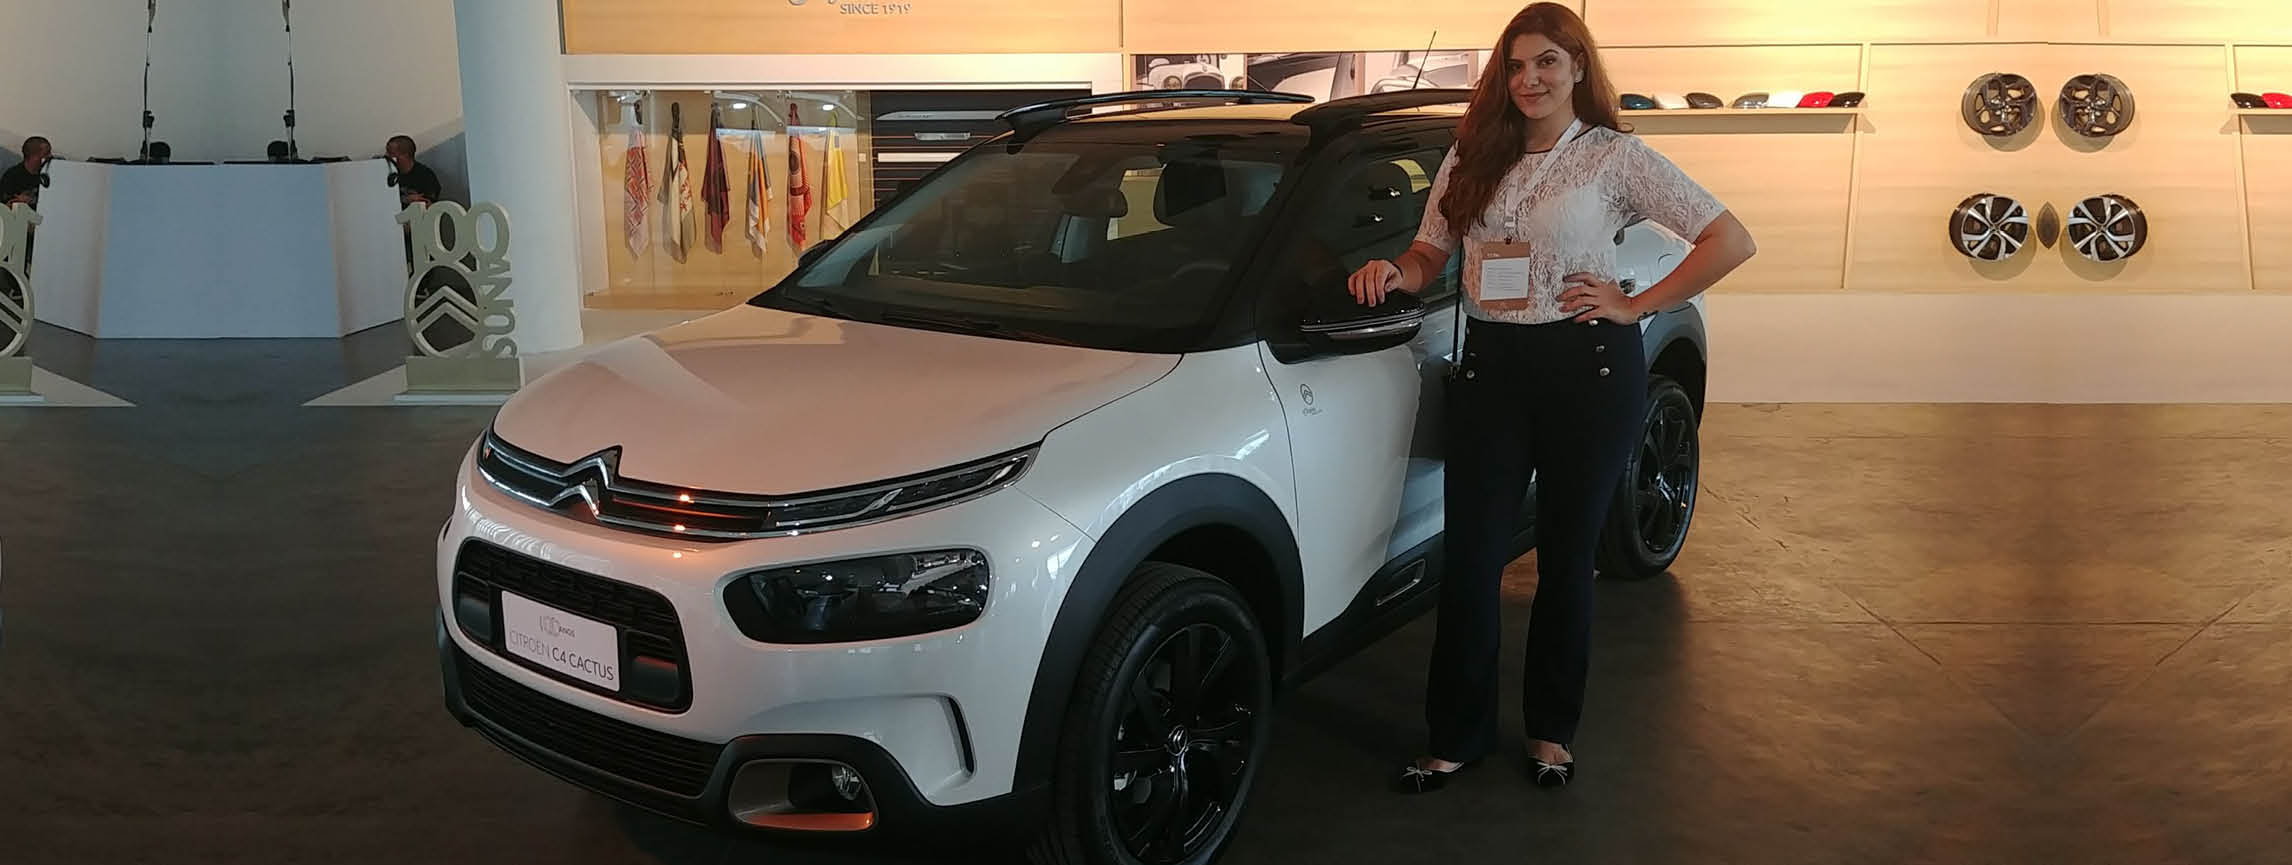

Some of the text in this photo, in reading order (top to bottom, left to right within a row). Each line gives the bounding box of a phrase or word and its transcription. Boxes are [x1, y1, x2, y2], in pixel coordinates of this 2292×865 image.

[840, 3, 879, 15] SINCE
[881, 4, 911, 15] 1919
[395, 200, 511, 264] 100
[552, 647, 567, 664] C4
[568, 653, 615, 681] CACTUS
